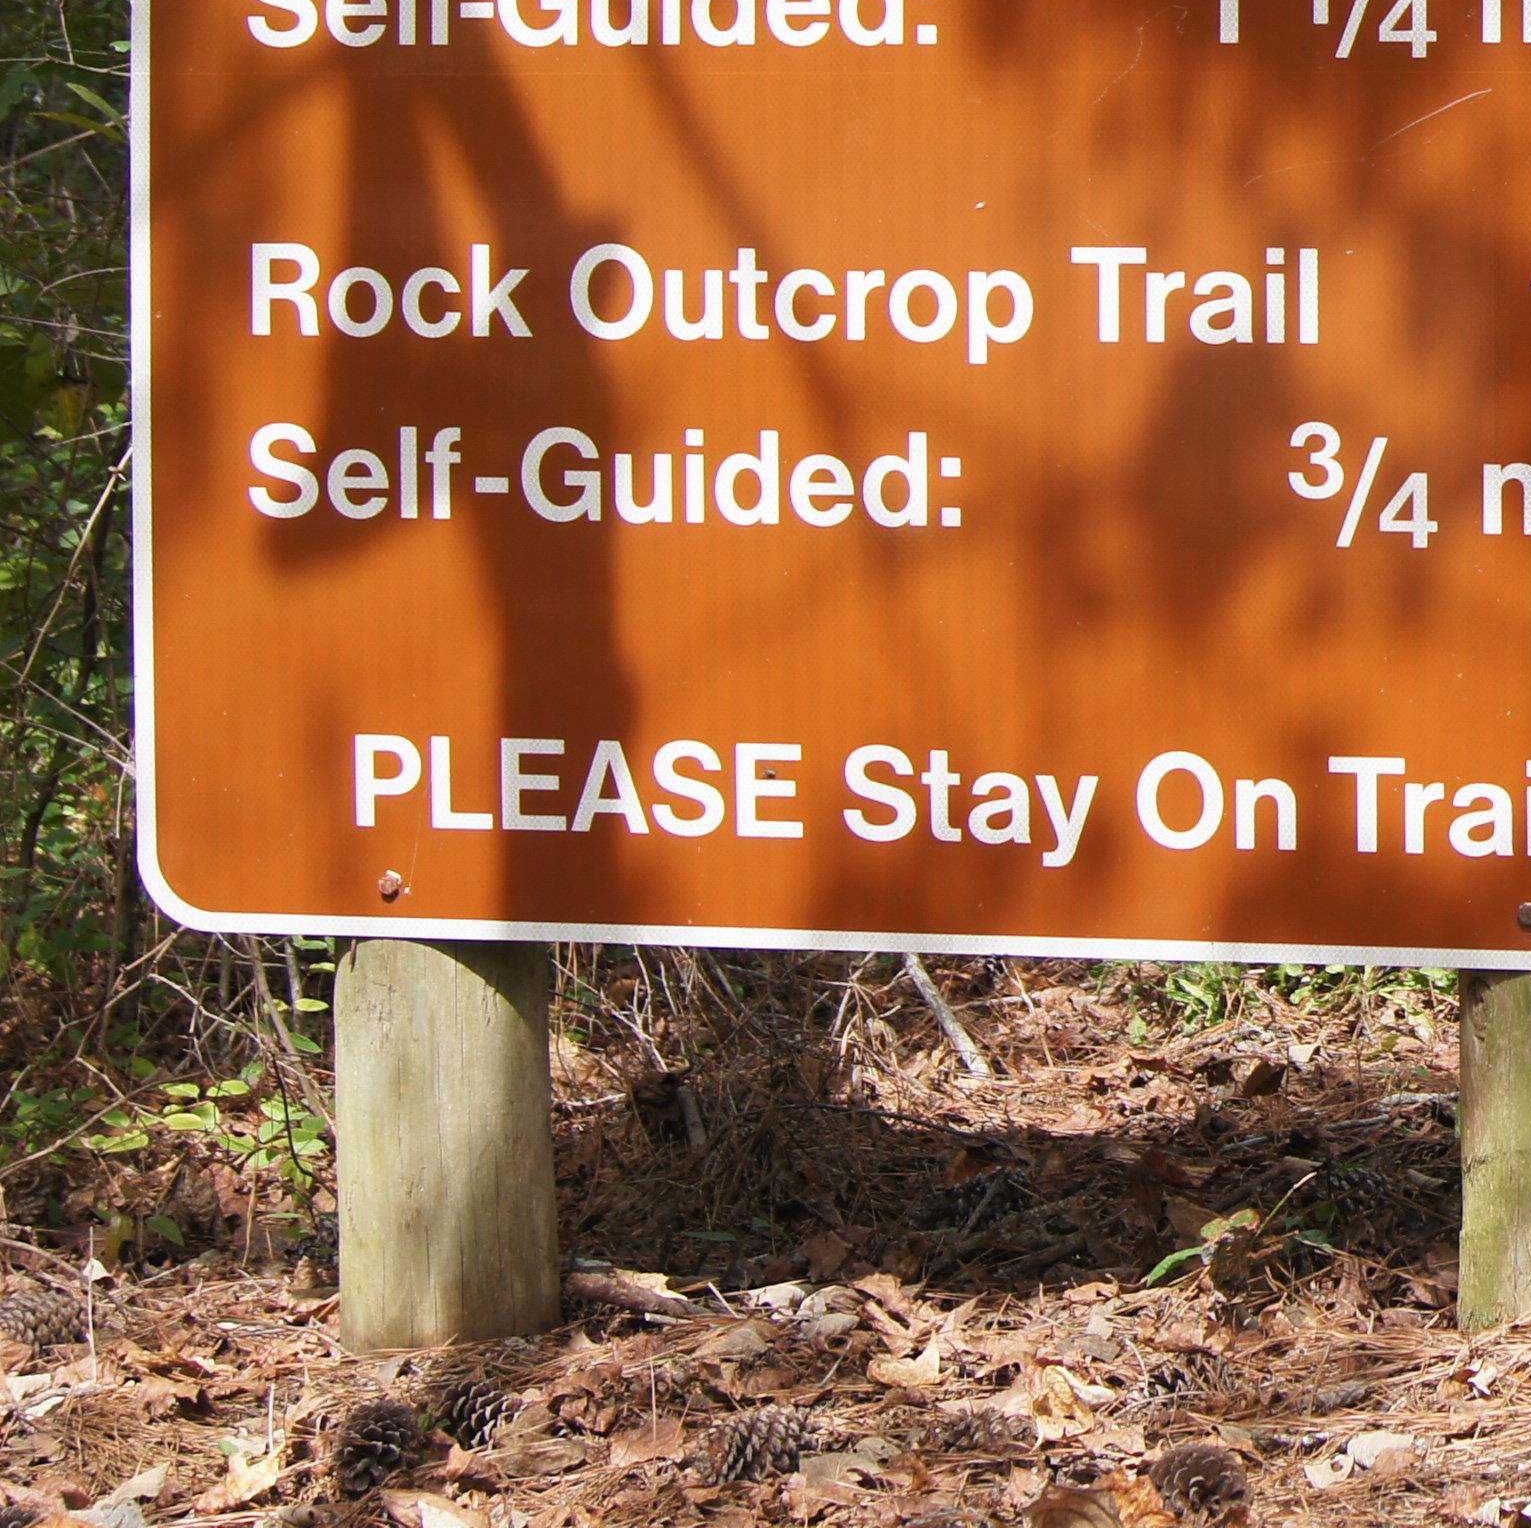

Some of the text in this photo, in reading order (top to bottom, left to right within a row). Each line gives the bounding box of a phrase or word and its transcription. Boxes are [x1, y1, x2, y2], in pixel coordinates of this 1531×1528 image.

[250, 243, 1319, 365] Rock Outcrop Trail
[247, 424, 962, 528] Self-Guided:
[354, 735, 804, 840] PLEASE
[843, 744, 1099, 868] Stay
[1136, 751, 1297, 852] On
